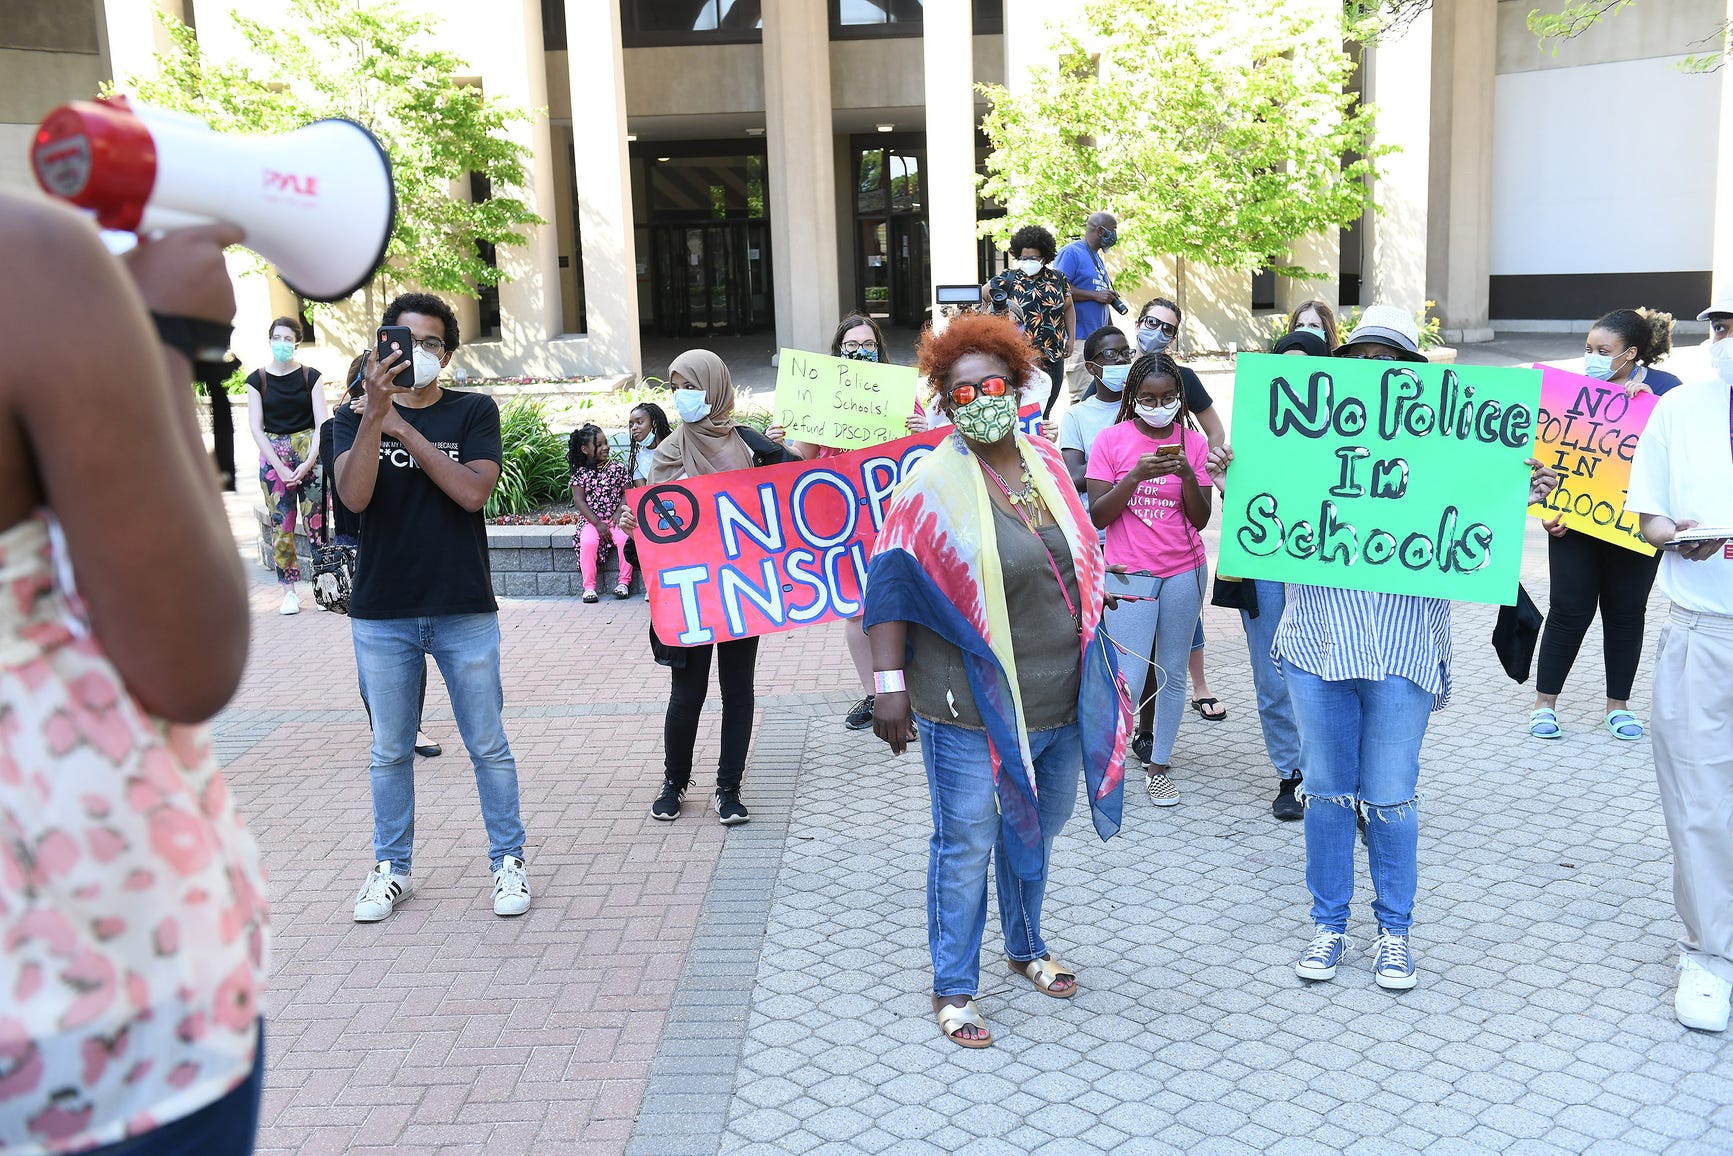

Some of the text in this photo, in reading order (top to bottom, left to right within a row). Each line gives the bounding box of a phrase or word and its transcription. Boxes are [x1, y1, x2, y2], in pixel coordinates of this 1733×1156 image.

[791, 357, 881, 393] No Police
[833, 391, 889, 418] Schools!
[1269, 368, 1532, 448] No Police
[1566, 386, 1630, 423] NO
[782, 409, 826, 436] Defund
[834, 422, 871, 442] DPSCD
[437, 442, 459, 450] BECAUSE
[1328, 446, 1410, 499] In
[1552, 450, 1601, 478] IN
[1137, 485, 1159, 496] FOR
[1237, 492, 1493, 574] Schools
